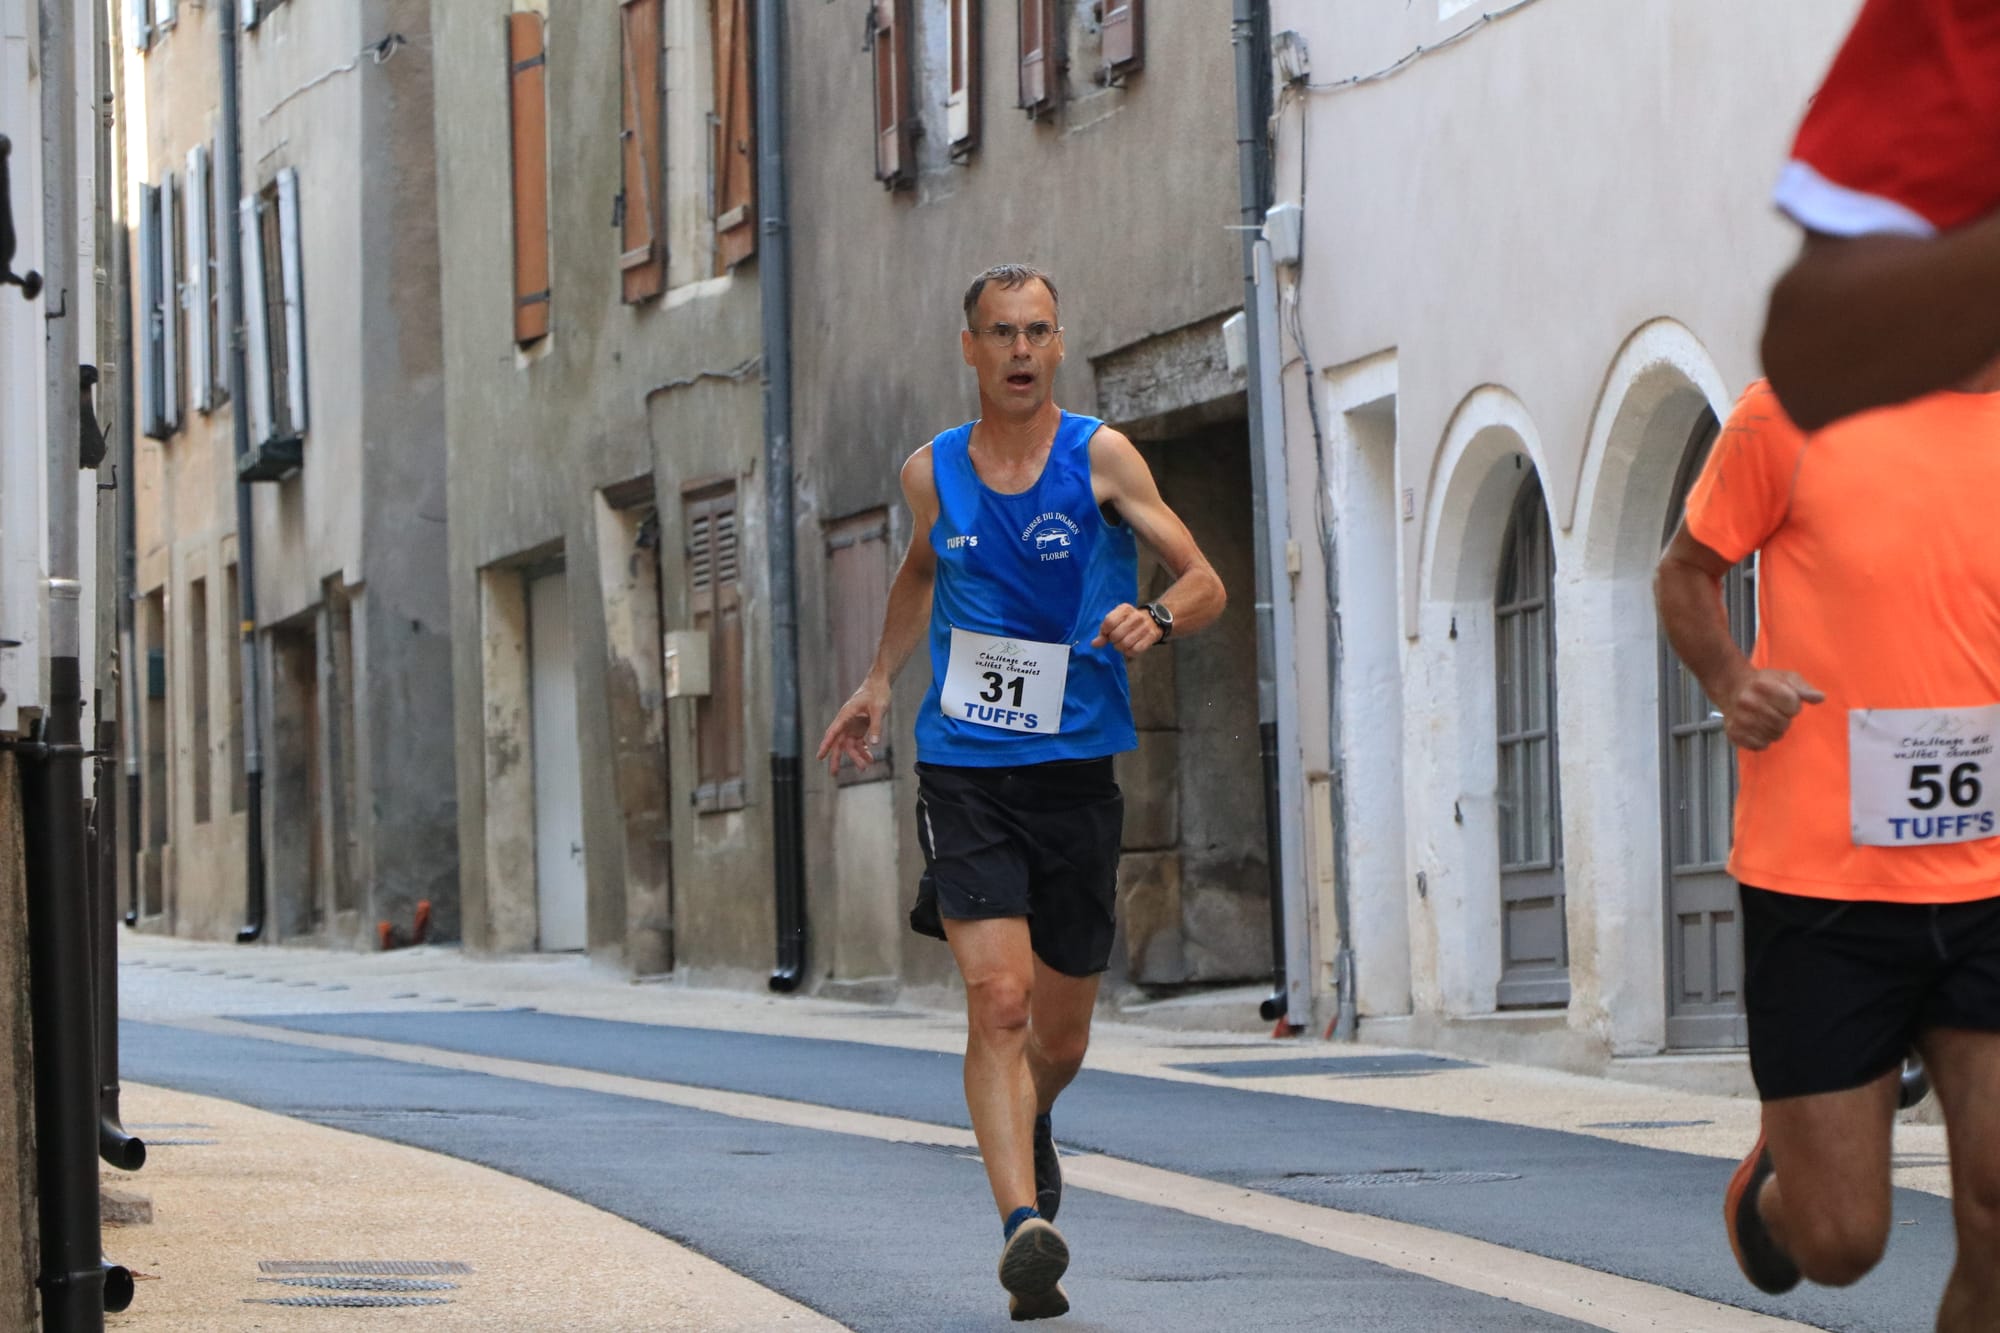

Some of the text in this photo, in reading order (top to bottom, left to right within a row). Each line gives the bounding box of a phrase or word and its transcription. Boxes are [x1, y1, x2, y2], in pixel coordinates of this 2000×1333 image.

[1021, 511, 1080, 541] COURSE DU DOLMEN
[946, 535, 978, 550] TUFF'S
[1040, 550, 1070, 561] FLORAC
[979, 652, 1019, 666] Challenge
[979, 671, 1025, 707] 31
[963, 702, 1038, 729] TUFF'S
[1901, 737, 1965, 750] Challenge
[1907, 762, 1983, 810] 56
[1887, 811, 1995, 840] TUFF'S
